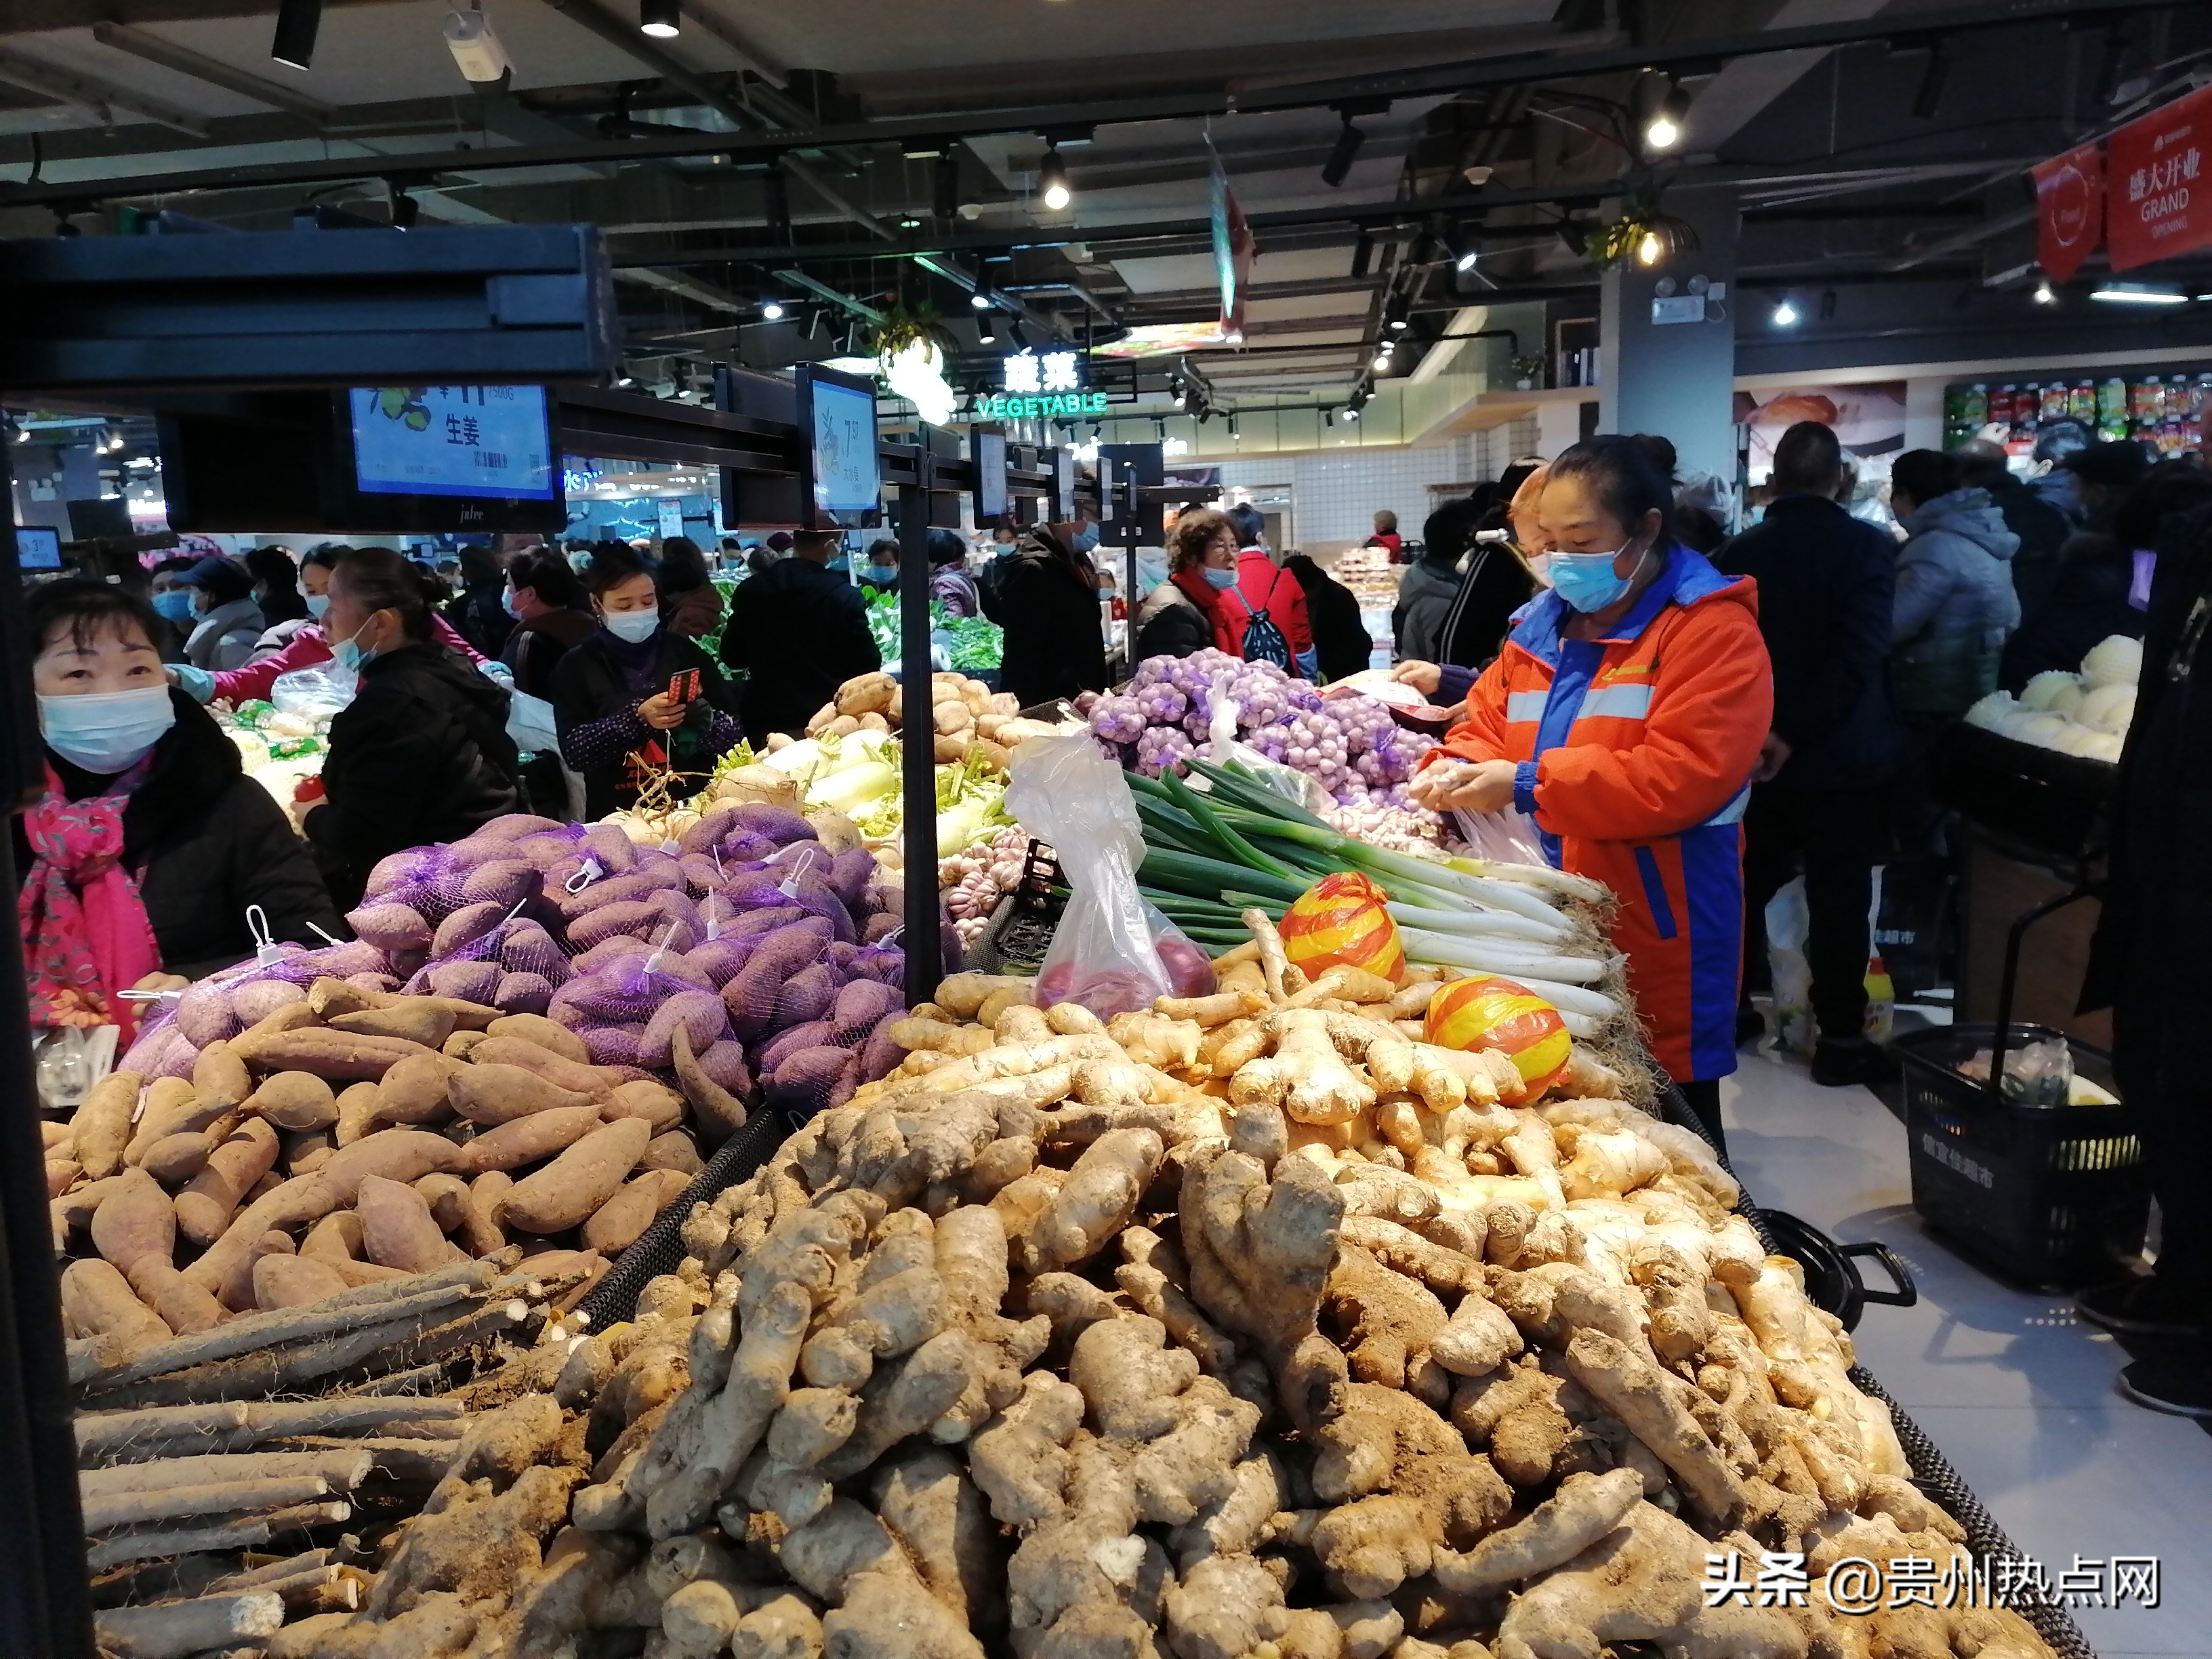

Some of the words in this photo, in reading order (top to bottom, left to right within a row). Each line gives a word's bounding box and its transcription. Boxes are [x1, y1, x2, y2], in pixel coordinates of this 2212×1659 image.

[2141, 187, 2190, 223] GRAND
[976, 392, 1108, 418] VEGETABLE
[446, 413, 480, 447] 生姜
